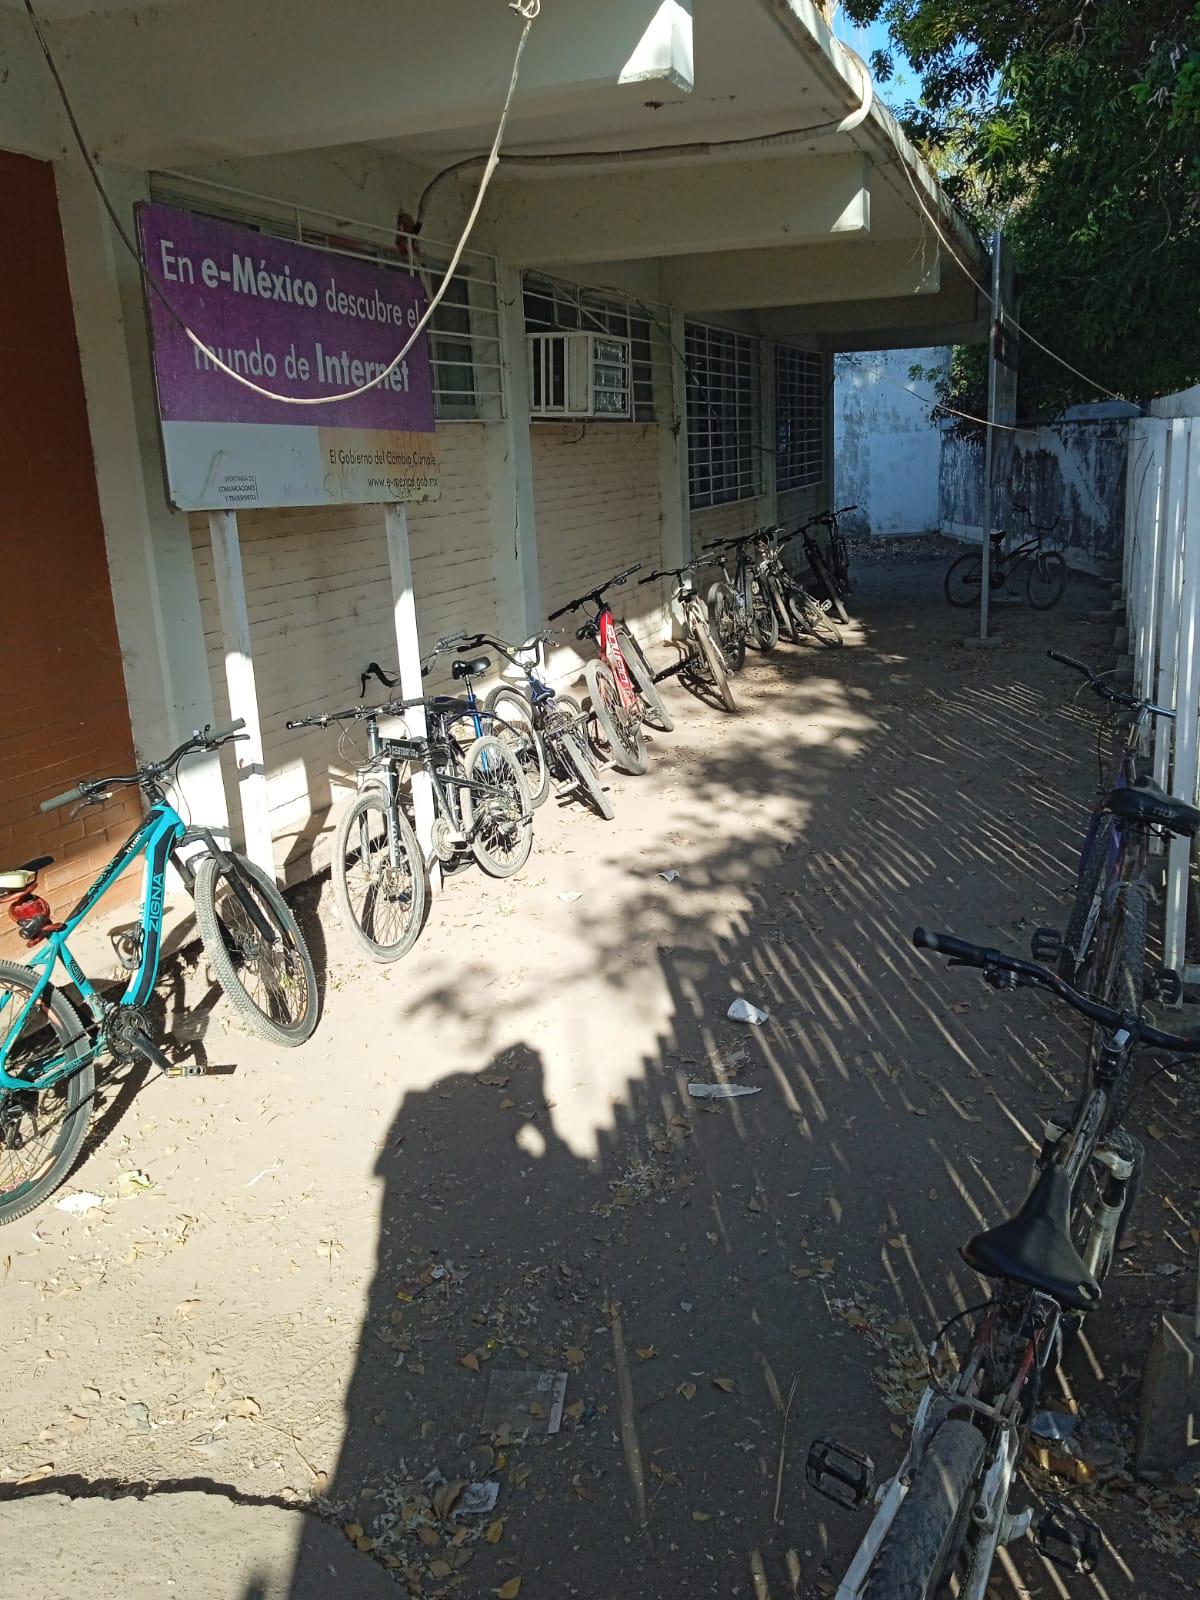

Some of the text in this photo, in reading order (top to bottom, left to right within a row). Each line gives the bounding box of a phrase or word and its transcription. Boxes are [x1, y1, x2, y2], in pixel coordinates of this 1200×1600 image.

[160, 239, 420, 329] En e-México descubre el
[193, 338, 409, 393] mundo de Internet
[329, 449, 337, 464] El
[338, 449, 373, 465] Gobierno
[374, 450, 385, 465] del
[149, 872, 163, 932] ZIGNA
